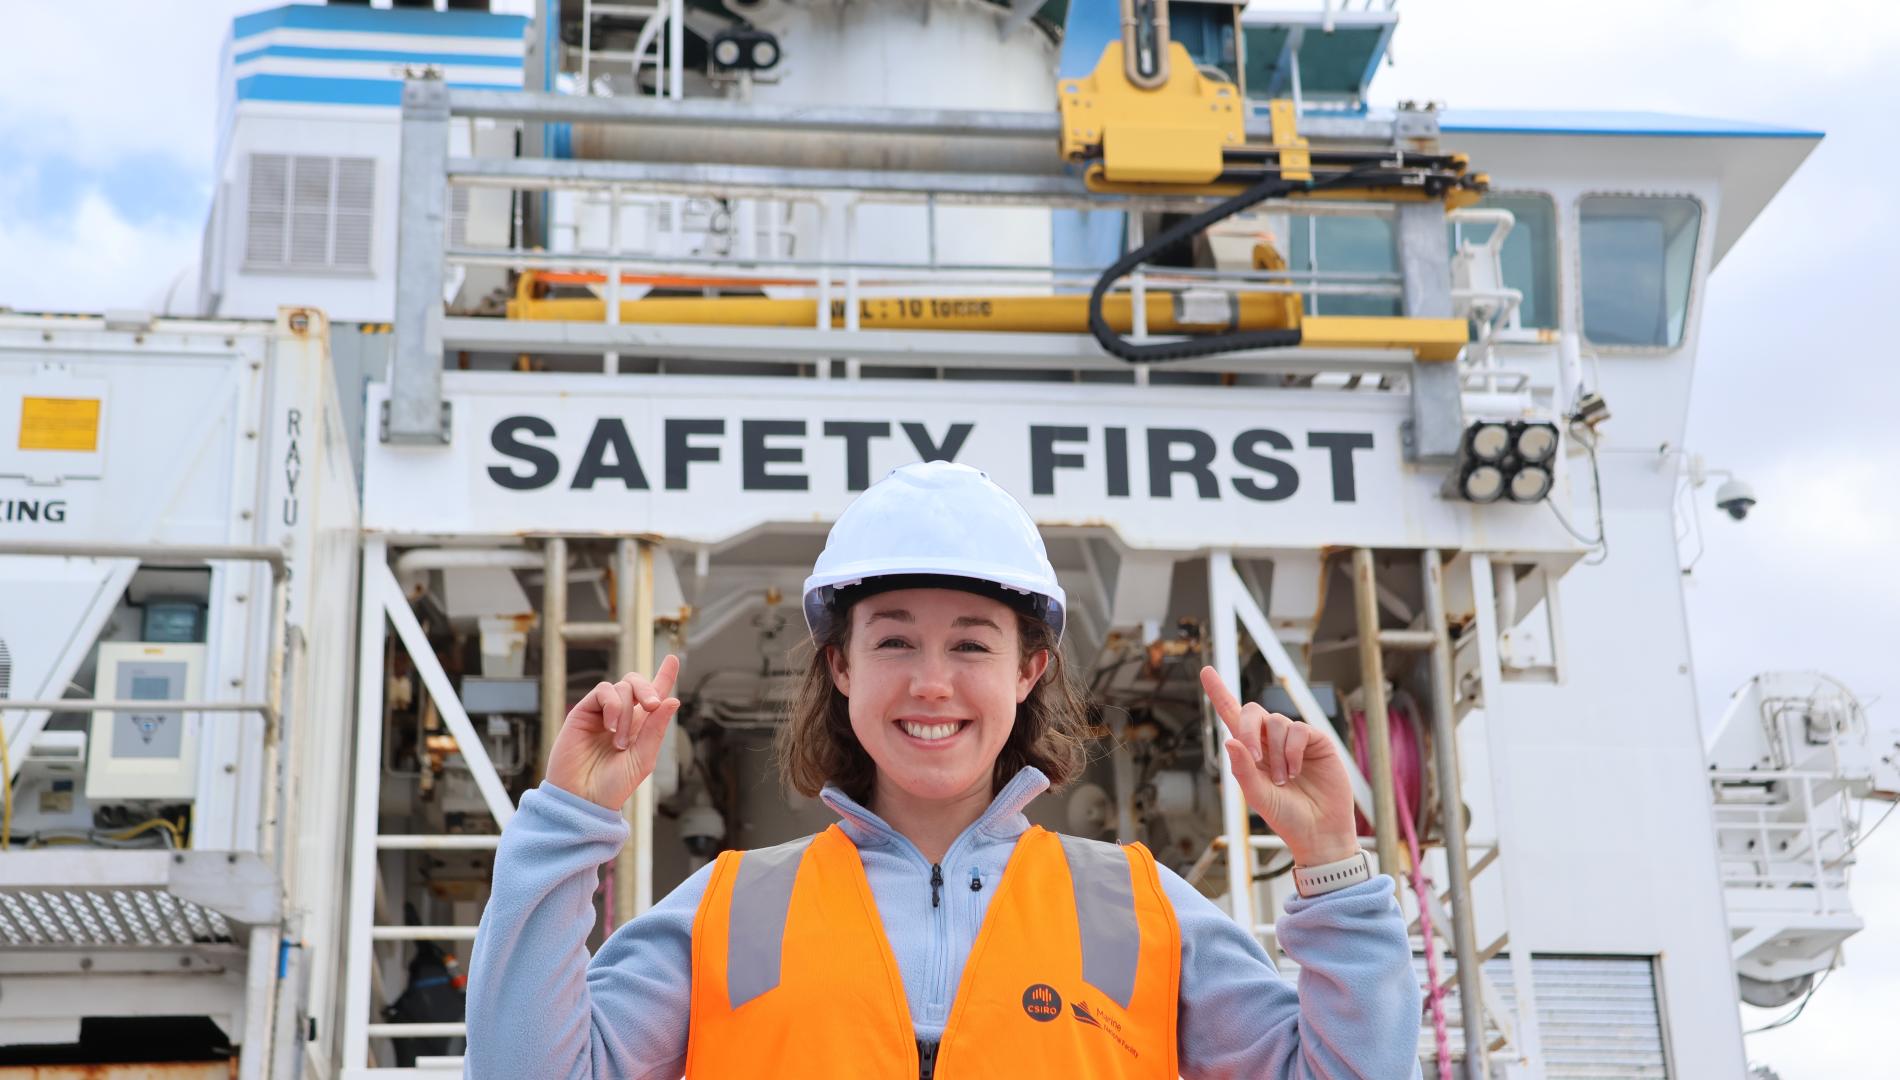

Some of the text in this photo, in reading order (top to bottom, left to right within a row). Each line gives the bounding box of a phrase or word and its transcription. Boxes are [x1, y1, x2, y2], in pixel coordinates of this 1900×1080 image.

[897, 299, 923, 318] 10
[487, 416, 1374, 502] SAFETY FIRST
[0, 500, 67, 522] ING
[1027, 1004, 1057, 1015] CSIRO
[1096, 1008, 1122, 1032] Marine
